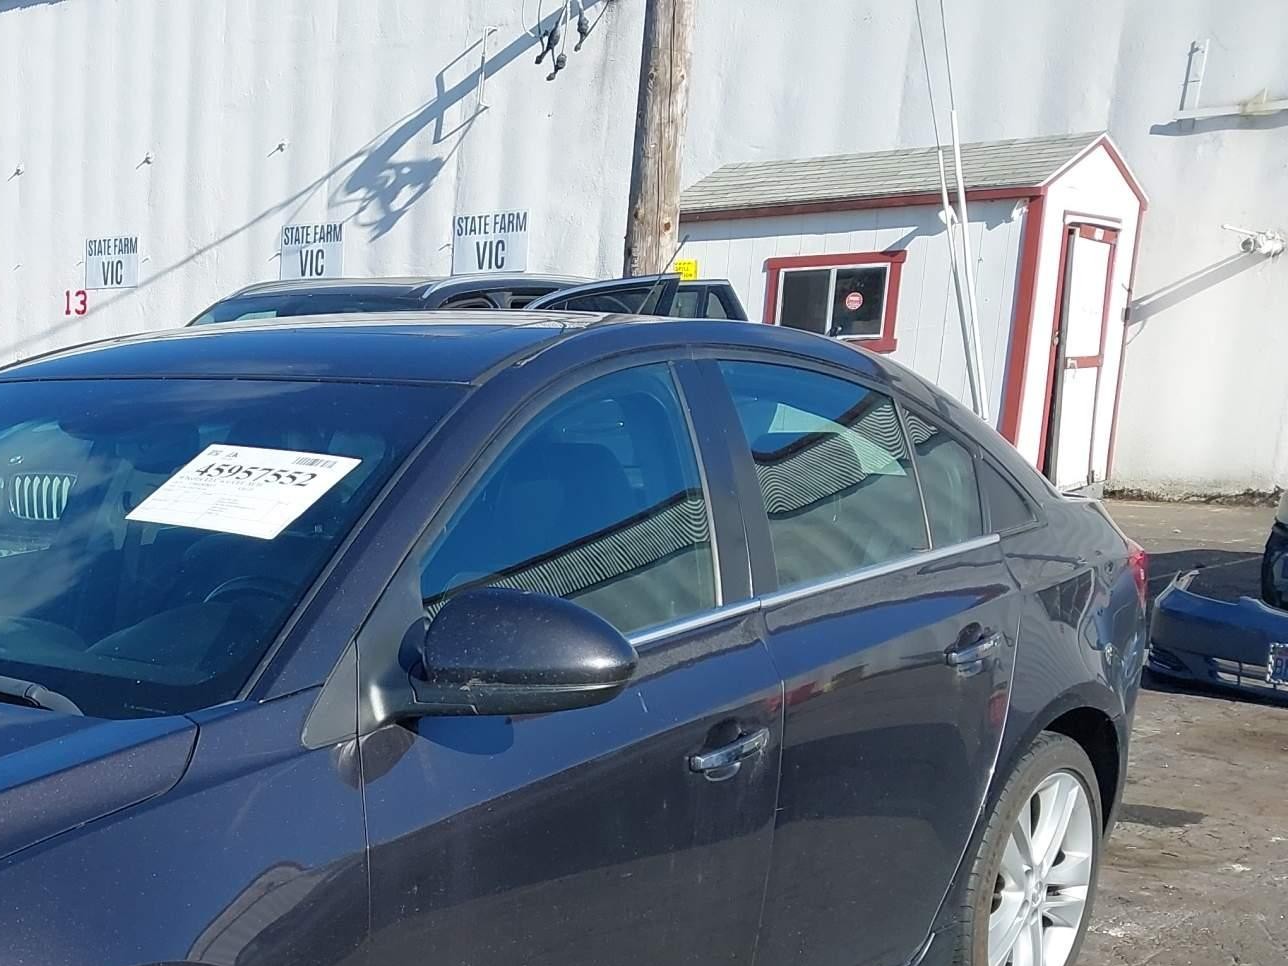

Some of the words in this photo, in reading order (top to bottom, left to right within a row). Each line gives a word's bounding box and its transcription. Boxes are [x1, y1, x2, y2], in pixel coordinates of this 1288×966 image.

[283, 225, 311, 246] STATE
[313, 223, 342, 243] FARM
[457, 215, 490, 236] STATE
[493, 212, 527, 233] FARM
[88, 239, 112, 256] STATE
[113, 237, 138, 255] FARM
[476, 240, 505, 270] VIC
[102, 260, 123, 286] VIC
[299, 249, 325, 277] VIC
[65, 290, 87, 315] 13
[196, 463, 317, 487] 45957552
